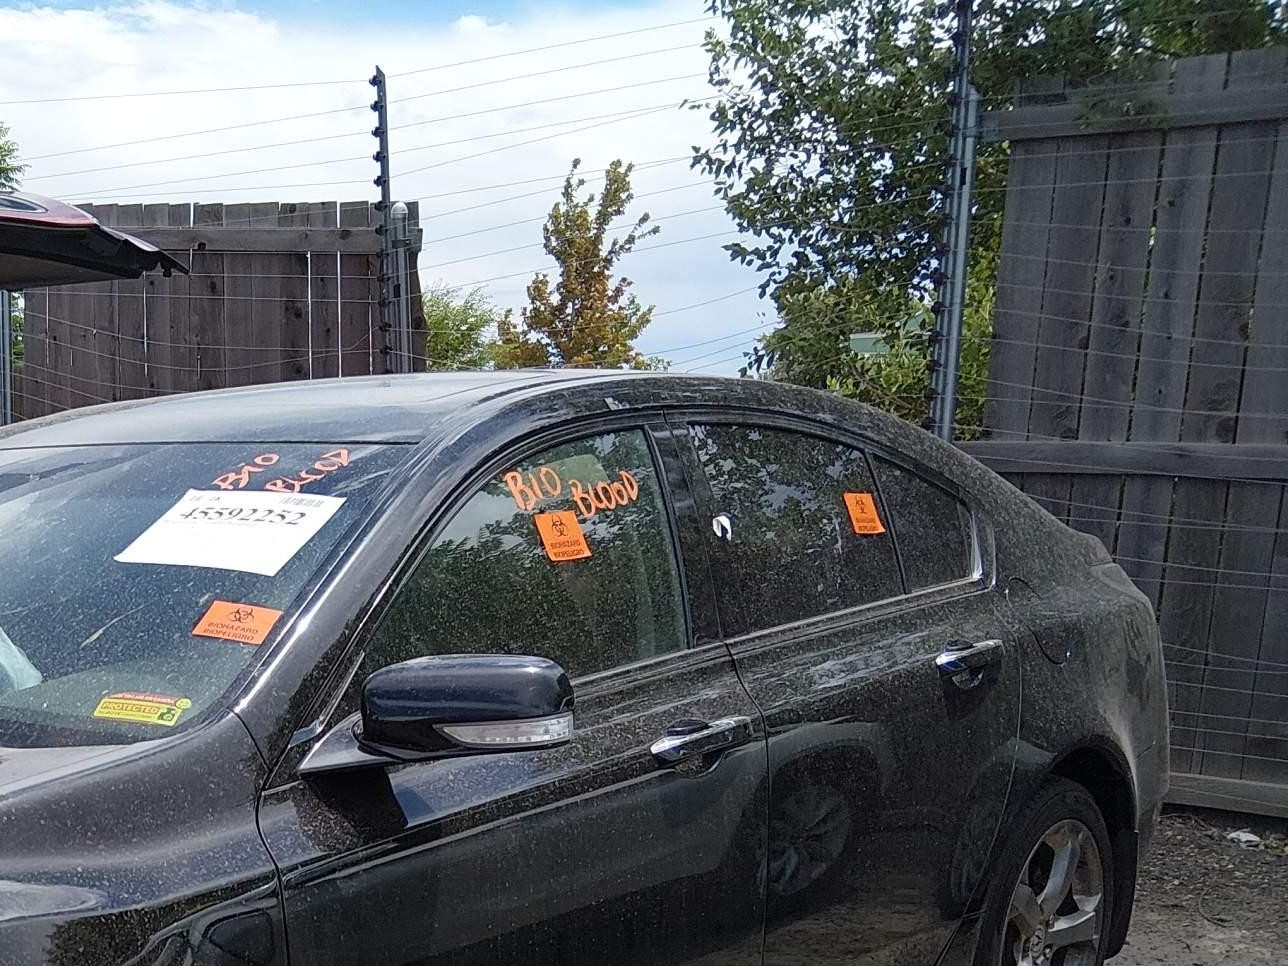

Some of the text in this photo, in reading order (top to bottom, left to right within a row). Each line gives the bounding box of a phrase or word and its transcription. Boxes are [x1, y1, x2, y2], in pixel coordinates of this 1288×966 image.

[504, 466, 562, 511] BIO
[568, 470, 639, 518] BLOOD
[180, 507, 307, 526] 45592252
[207, 622, 259, 635] BIOHAZARD
[101, 702, 159, 714] PROTECTED
